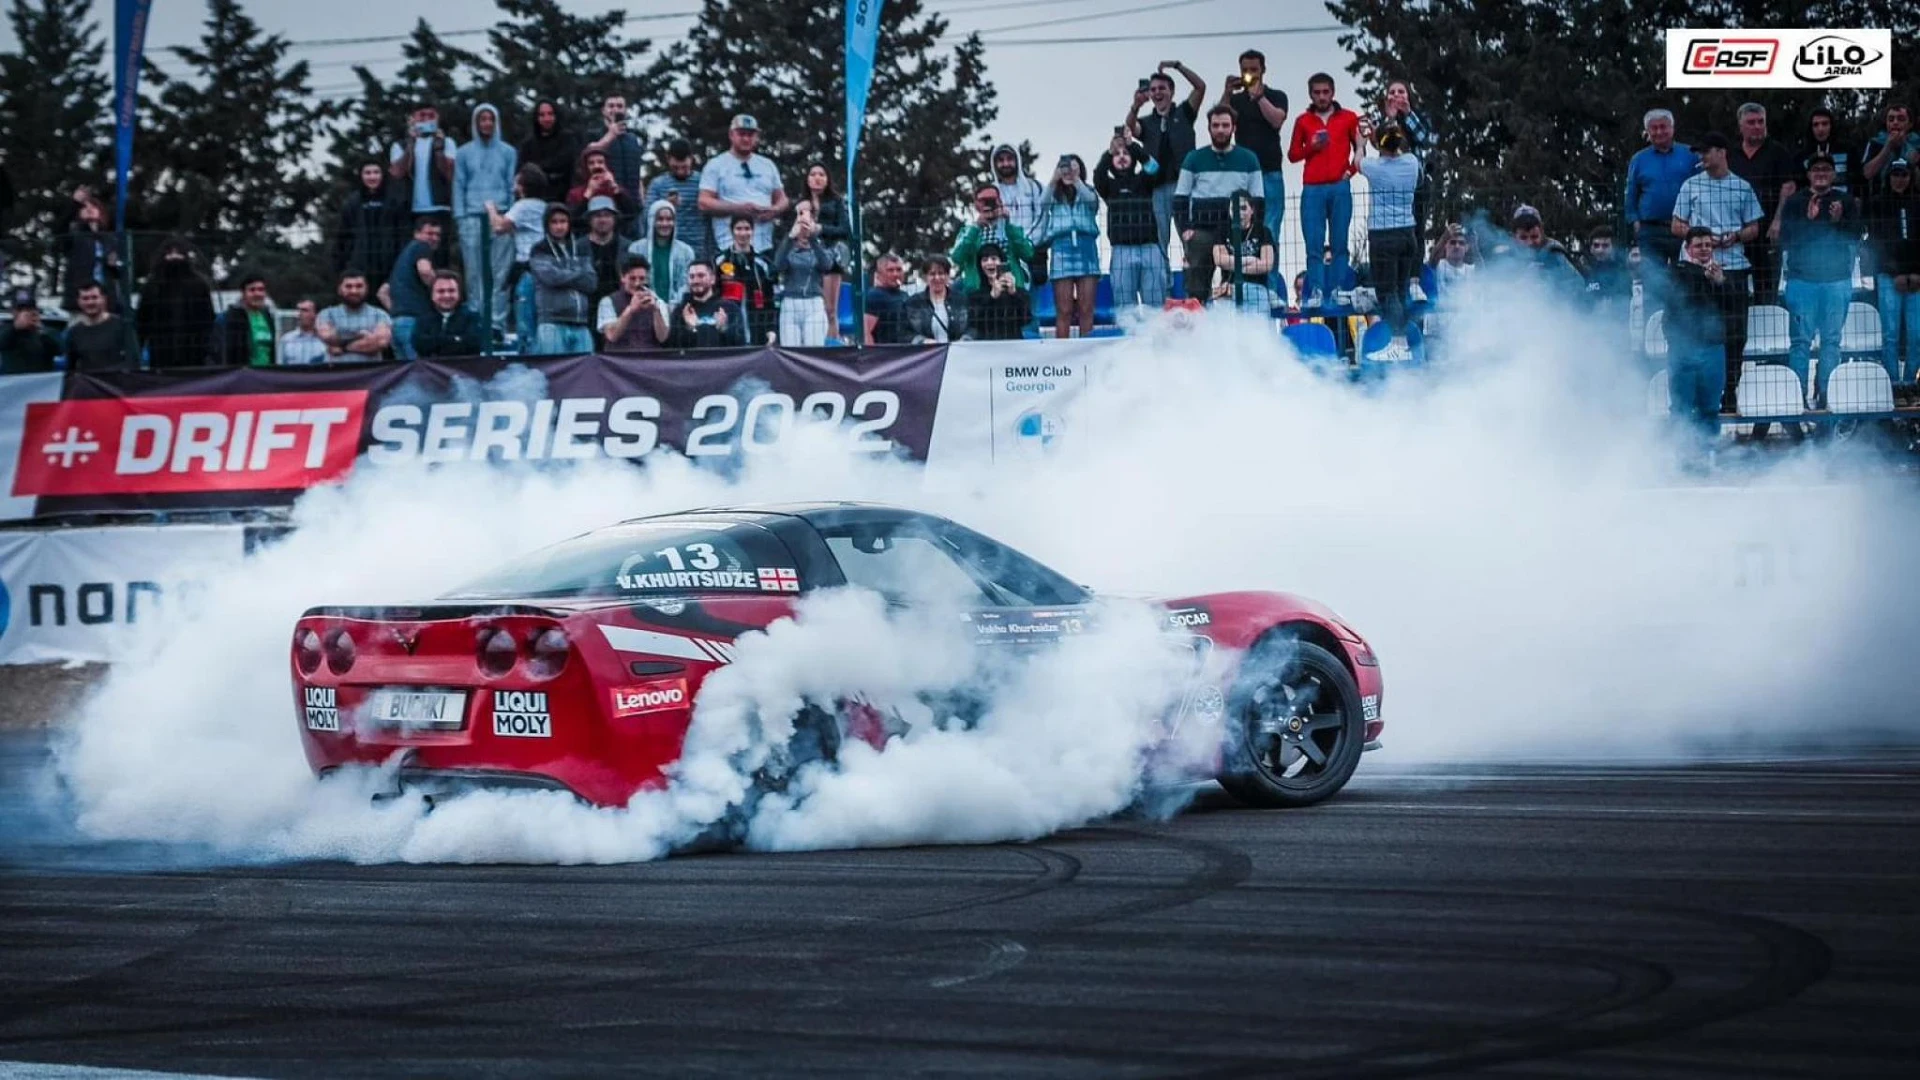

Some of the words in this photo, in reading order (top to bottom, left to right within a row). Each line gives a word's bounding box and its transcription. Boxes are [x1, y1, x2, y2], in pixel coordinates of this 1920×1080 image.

[855, 0, 868, 27] SO
[1005, 366, 1039, 378] BMW
[1042, 366, 1072, 377] Club
[1006, 381, 1056, 393] Georgia
[116, 407, 349, 475] DRIFT
[368, 397, 660, 464] SERIES
[686, 390, 899, 457] 2022
[656, 543, 720, 571] 13
[615, 572, 758, 589] V.KHURTSIDZE
[1170, 612, 1211, 627] SOCAR
[304, 688, 336, 708] LIQUI
[495, 690, 547, 713] LIQUI
[616, 689, 683, 710] Lenovo
[308, 709, 338, 728] MOLY
[496, 714, 548, 734] MOLY
